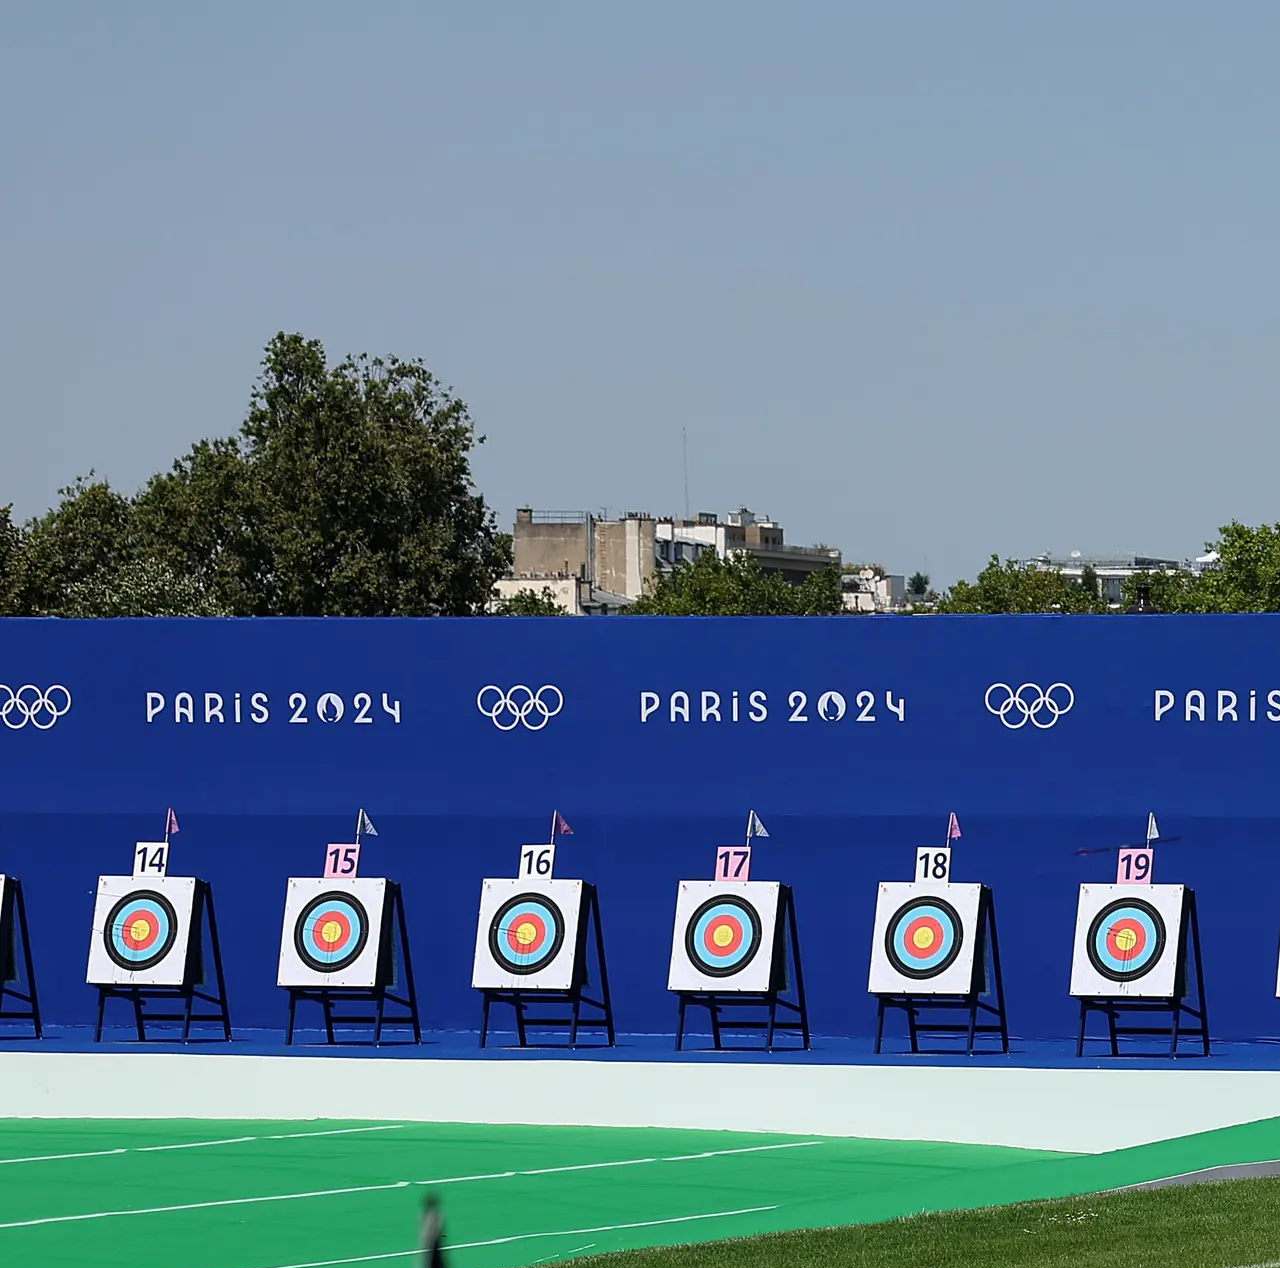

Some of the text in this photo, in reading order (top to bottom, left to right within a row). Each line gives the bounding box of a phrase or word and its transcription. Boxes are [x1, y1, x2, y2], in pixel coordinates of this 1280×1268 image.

[289, 693, 400, 723] 2024
[789, 691, 904, 721] 2024
[137, 846, 165, 873] 14
[329, 848, 357, 875] 15
[523, 849, 551, 875] 16
[718, 850, 749, 878] 17
[919, 852, 948, 880] 18
[1120, 853, 1150, 881] 19
